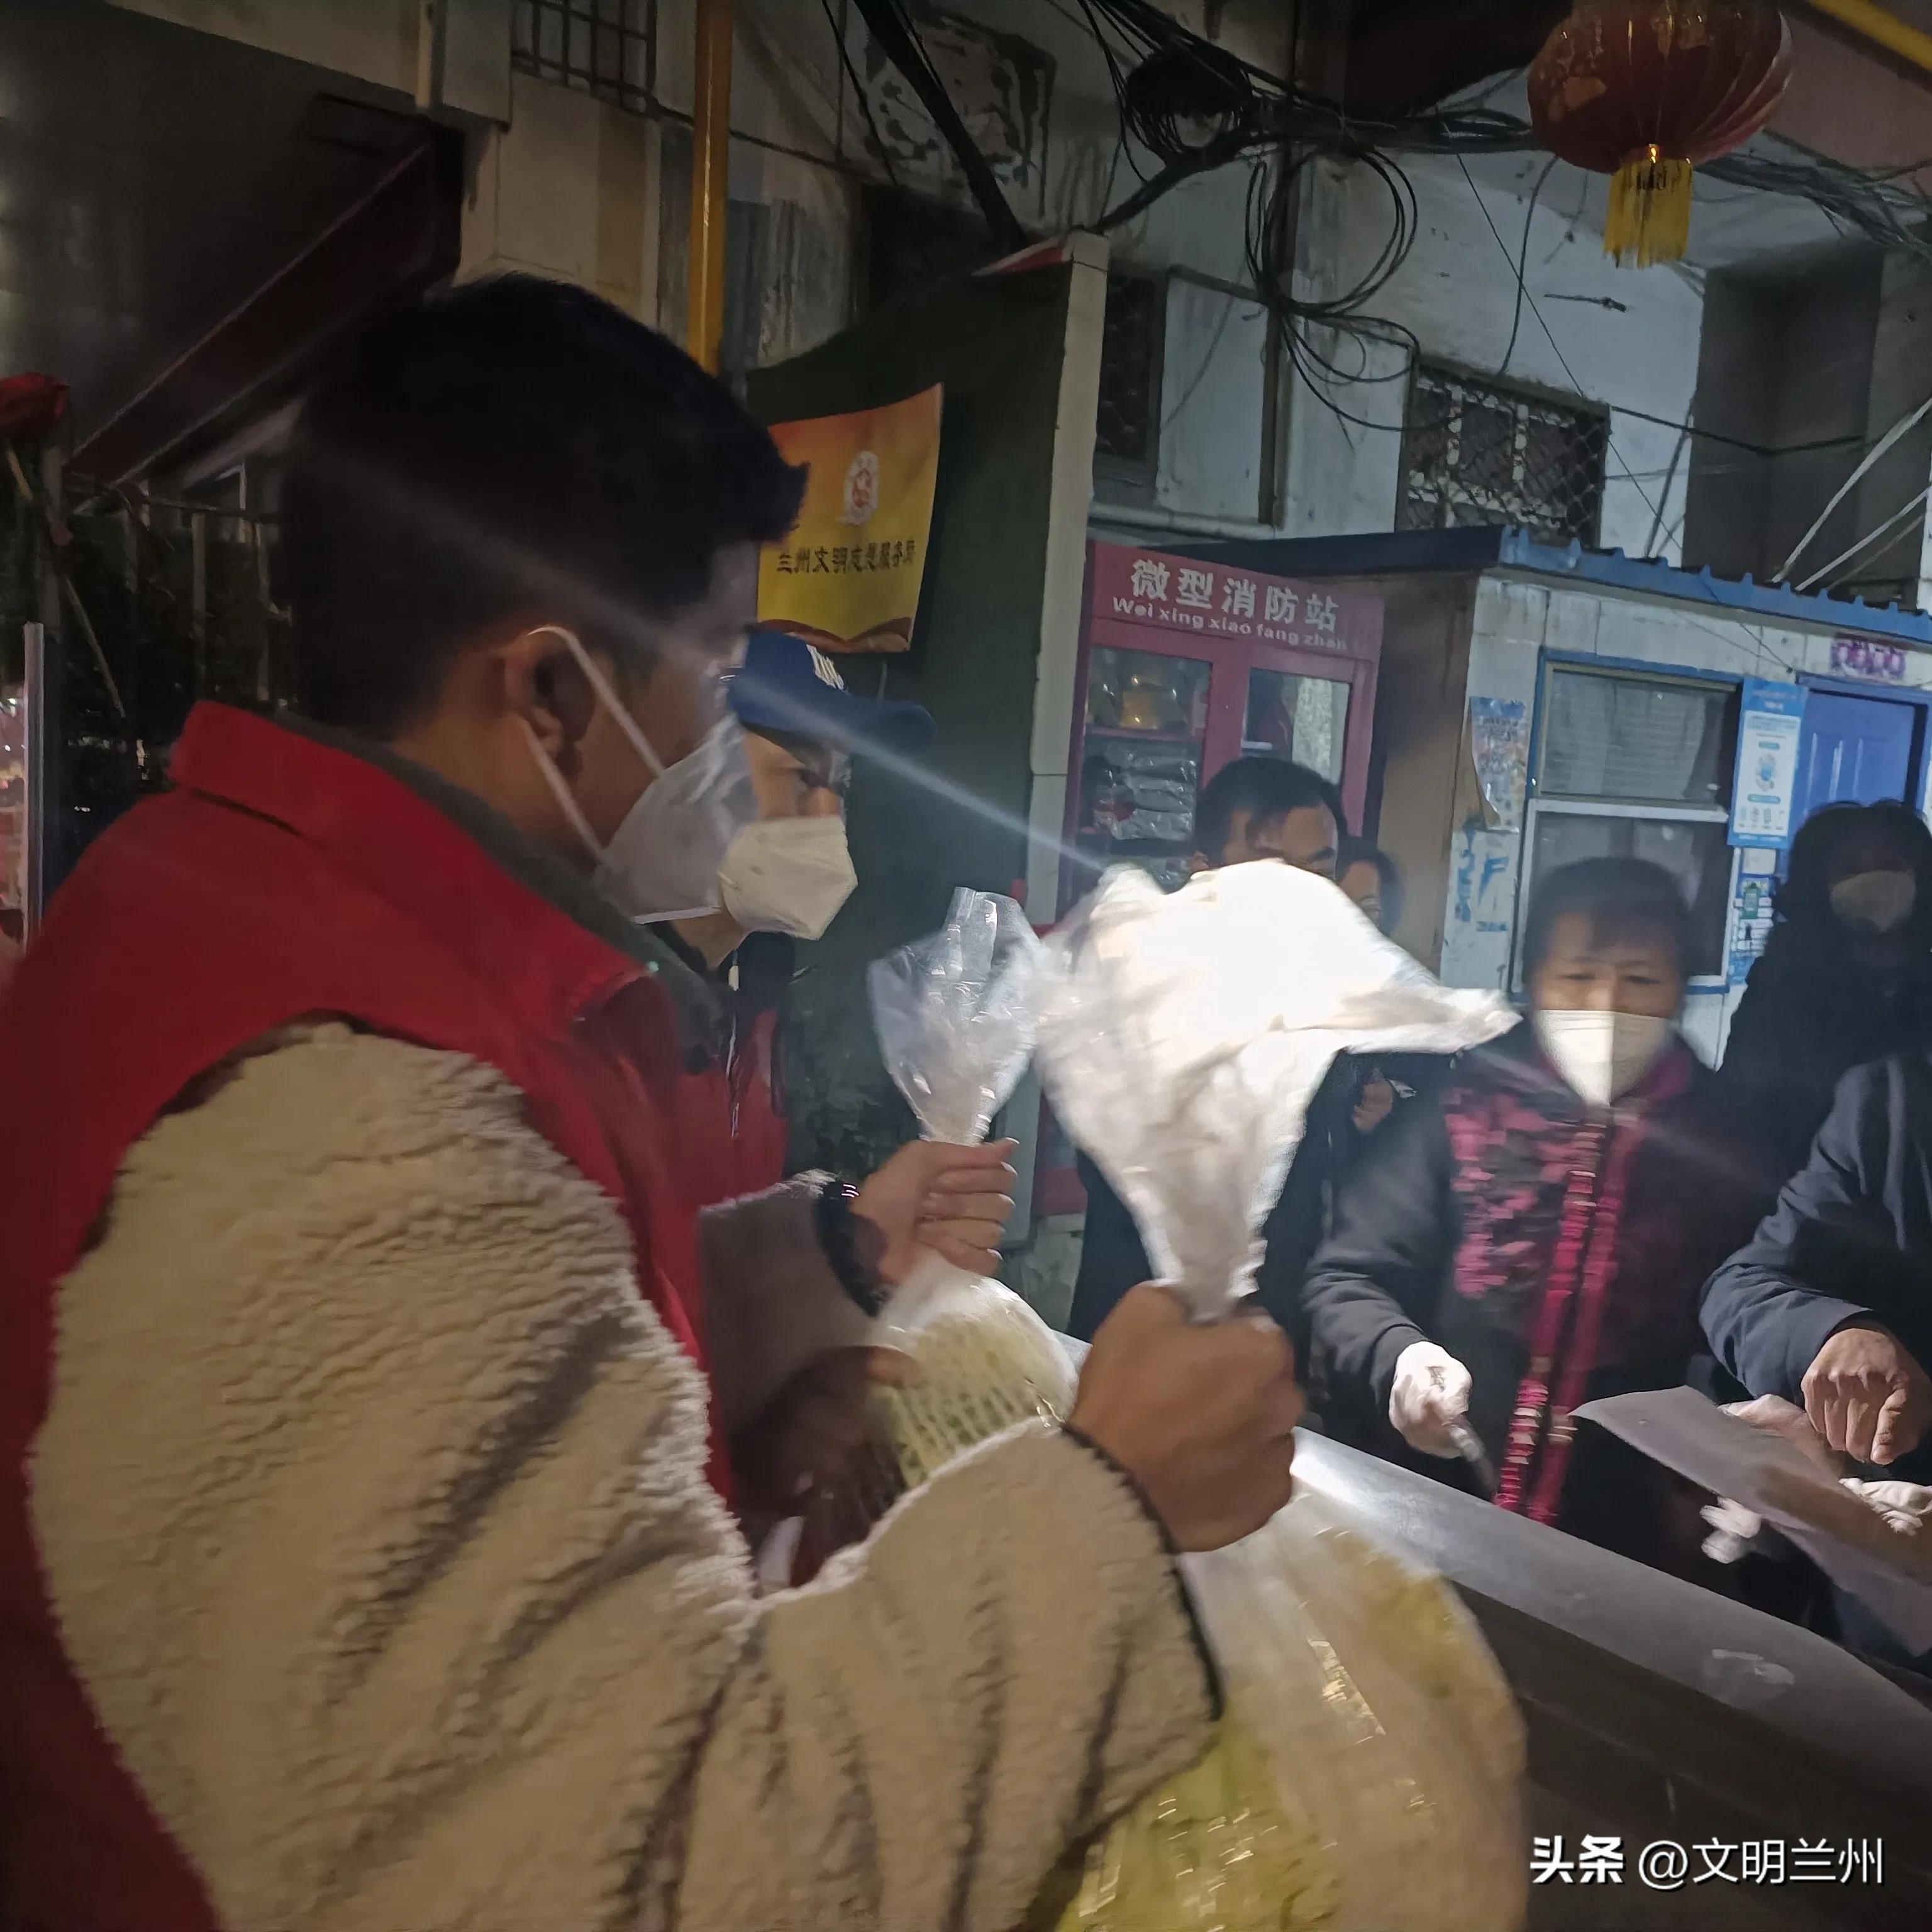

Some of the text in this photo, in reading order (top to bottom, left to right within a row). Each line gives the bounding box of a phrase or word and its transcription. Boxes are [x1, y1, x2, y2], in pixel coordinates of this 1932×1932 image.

[1113, 597, 1348, 652] Wei xing xiao fang zhan
[1131, 558, 1340, 633] 微型消防站
